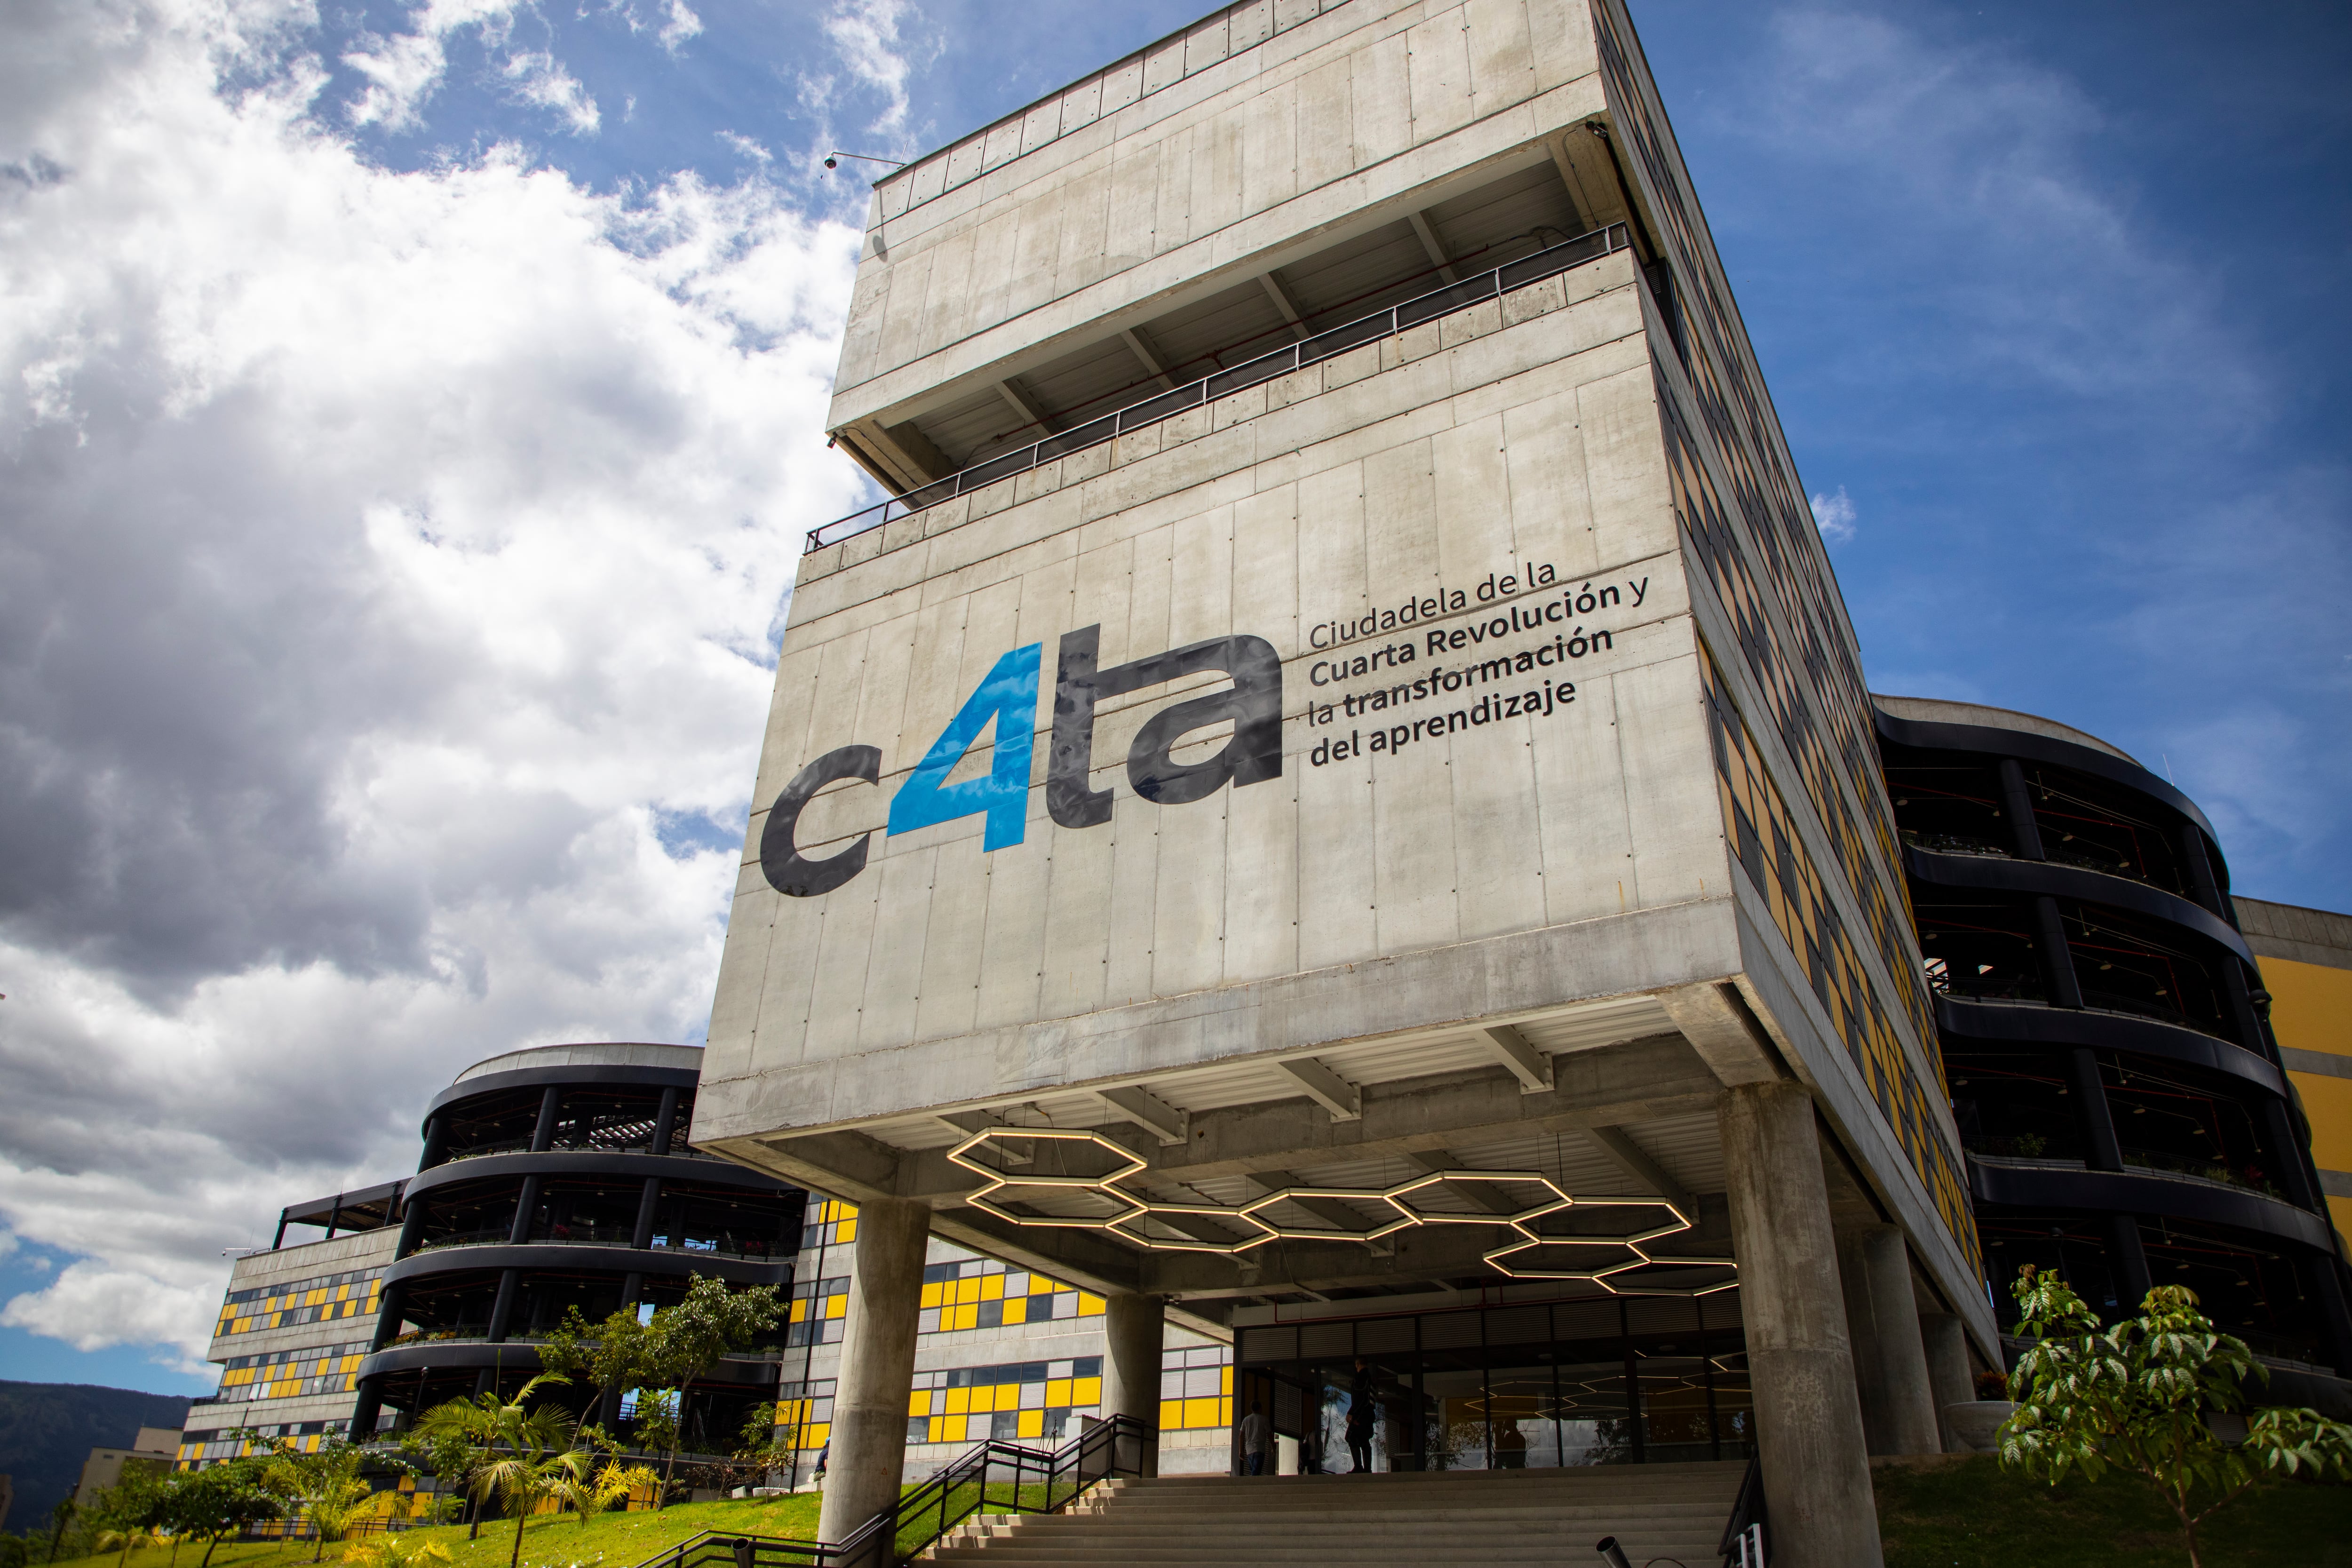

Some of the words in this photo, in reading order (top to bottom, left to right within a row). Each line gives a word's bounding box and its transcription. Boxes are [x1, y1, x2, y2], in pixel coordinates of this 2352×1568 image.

[1310, 588, 1466, 648] Ciudadela
[1476, 573, 1517, 602] de
[1527, 562, 1556, 588] la
[1310, 643, 1415, 686] Cuarta
[1427, 582, 1620, 656] Revolución
[1629, 577, 1649, 608] y
[1309, 701, 1334, 727] la
[1343, 627, 1613, 717] transformación
[1310, 730, 1360, 767] del
[1370, 679, 1576, 755] aprendizaje
[760, 623, 1282, 897] c4ta
